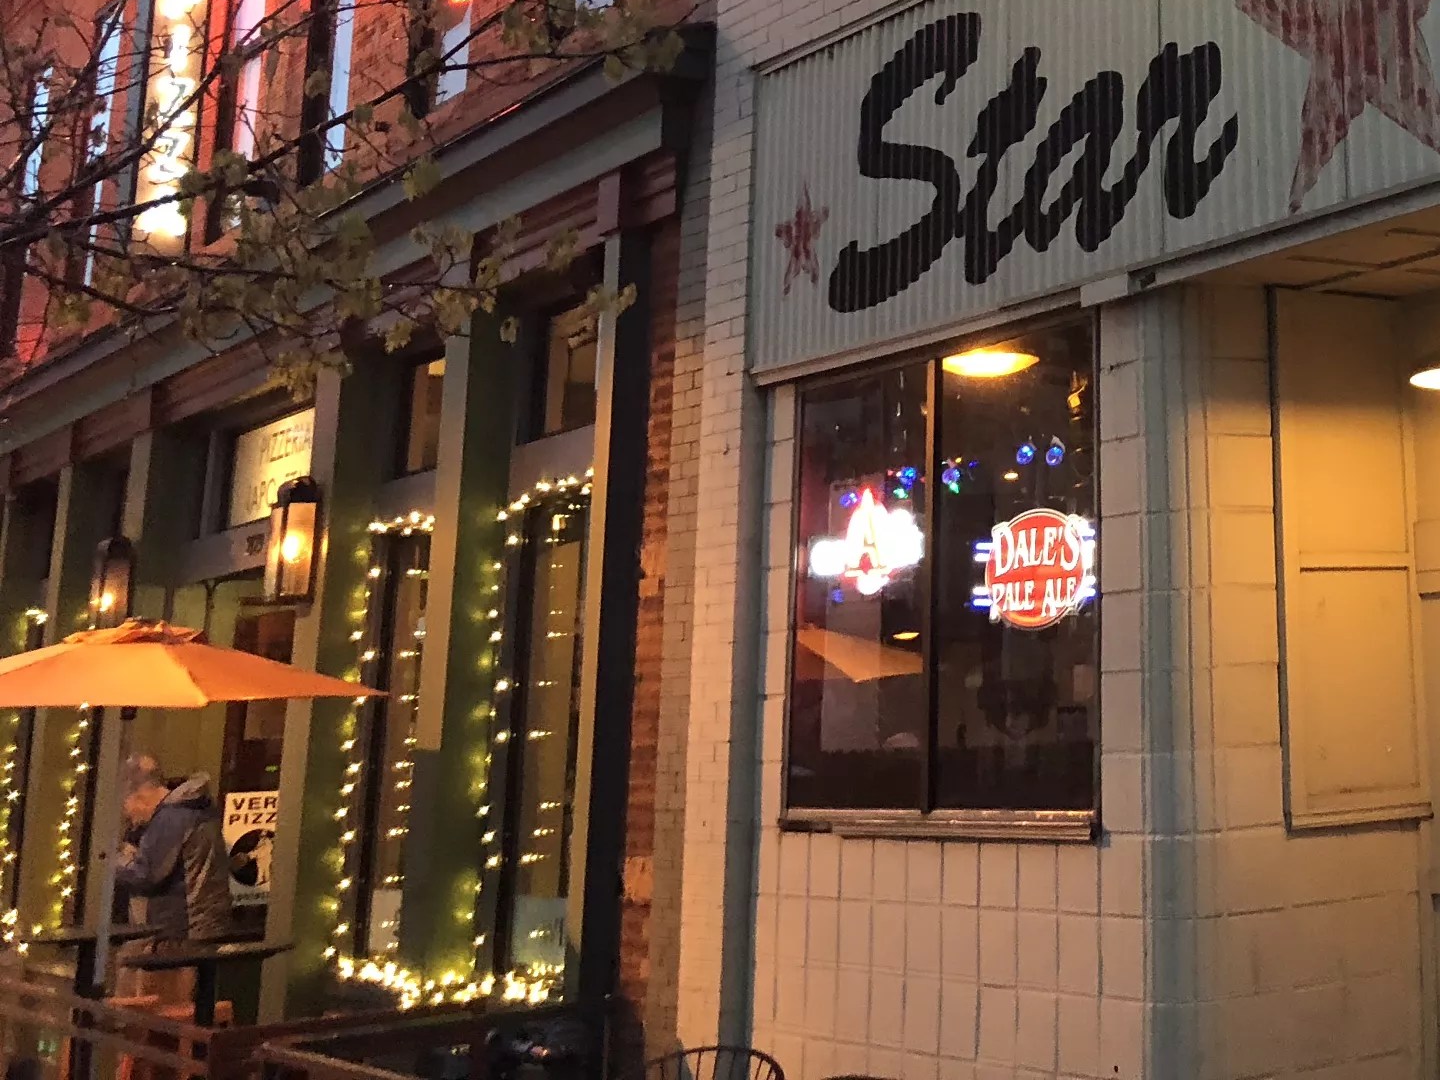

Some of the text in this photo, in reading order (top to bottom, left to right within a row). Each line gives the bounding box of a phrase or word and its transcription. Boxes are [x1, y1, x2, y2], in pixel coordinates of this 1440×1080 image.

[829, 12, 1238, 313] Star
[992, 514, 1082, 578] DALE'S
[990, 576, 1077, 621] PALE ALE
